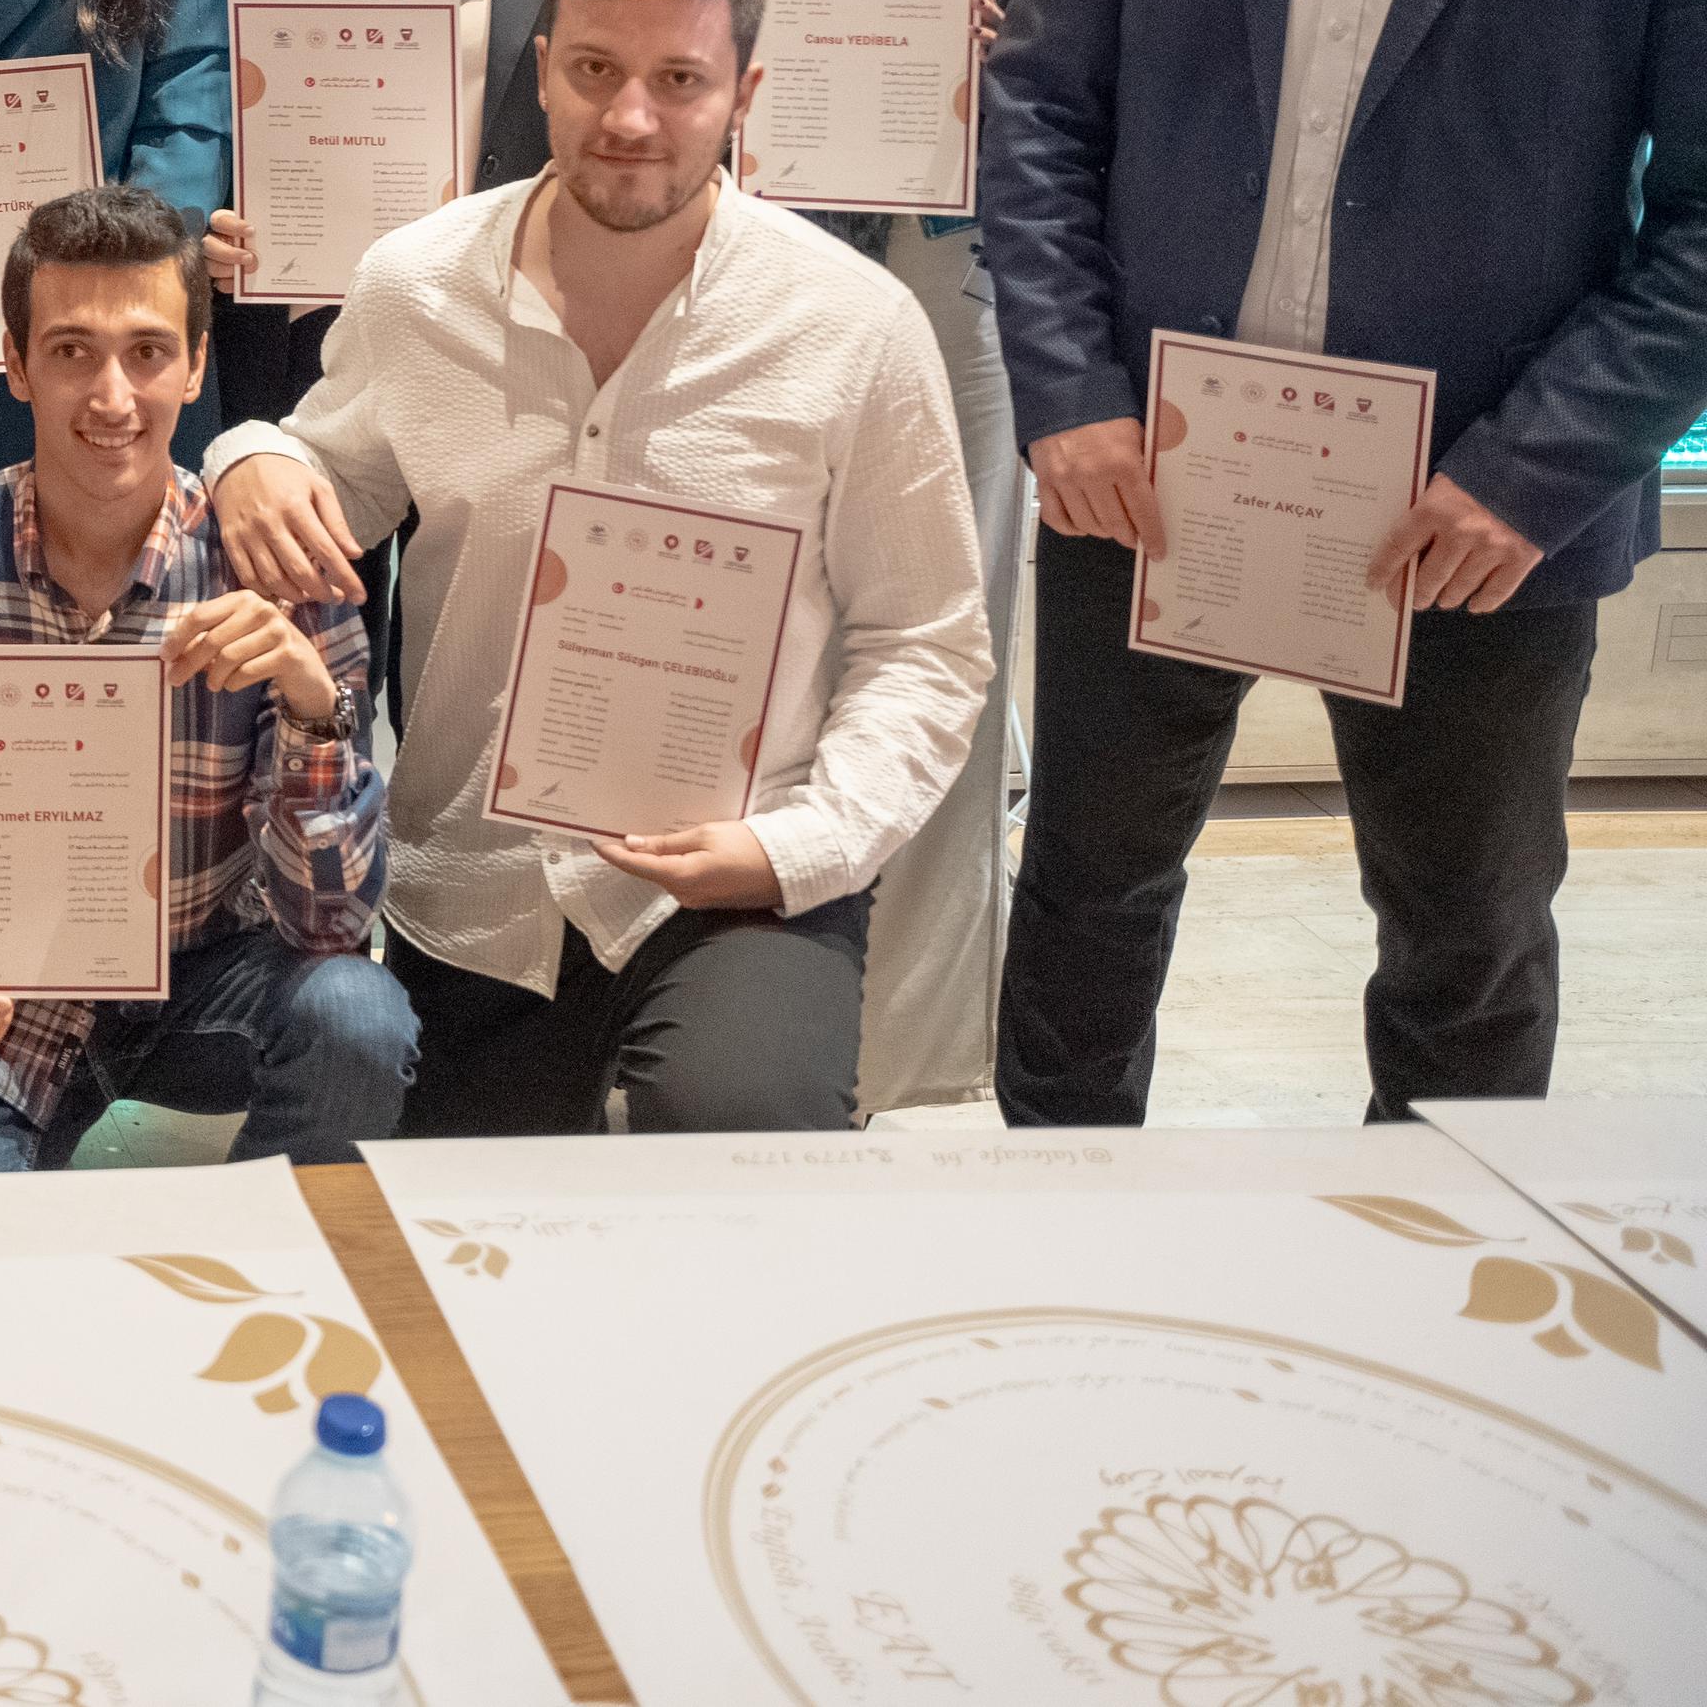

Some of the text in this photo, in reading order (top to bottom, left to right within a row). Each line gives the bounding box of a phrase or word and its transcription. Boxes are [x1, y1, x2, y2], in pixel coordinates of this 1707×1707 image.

[804, 33, 843, 46] Cansu
[308, 134, 387, 148] Betül MUTLU
[1232, 492, 1325, 520] Zafer AKÇAY
